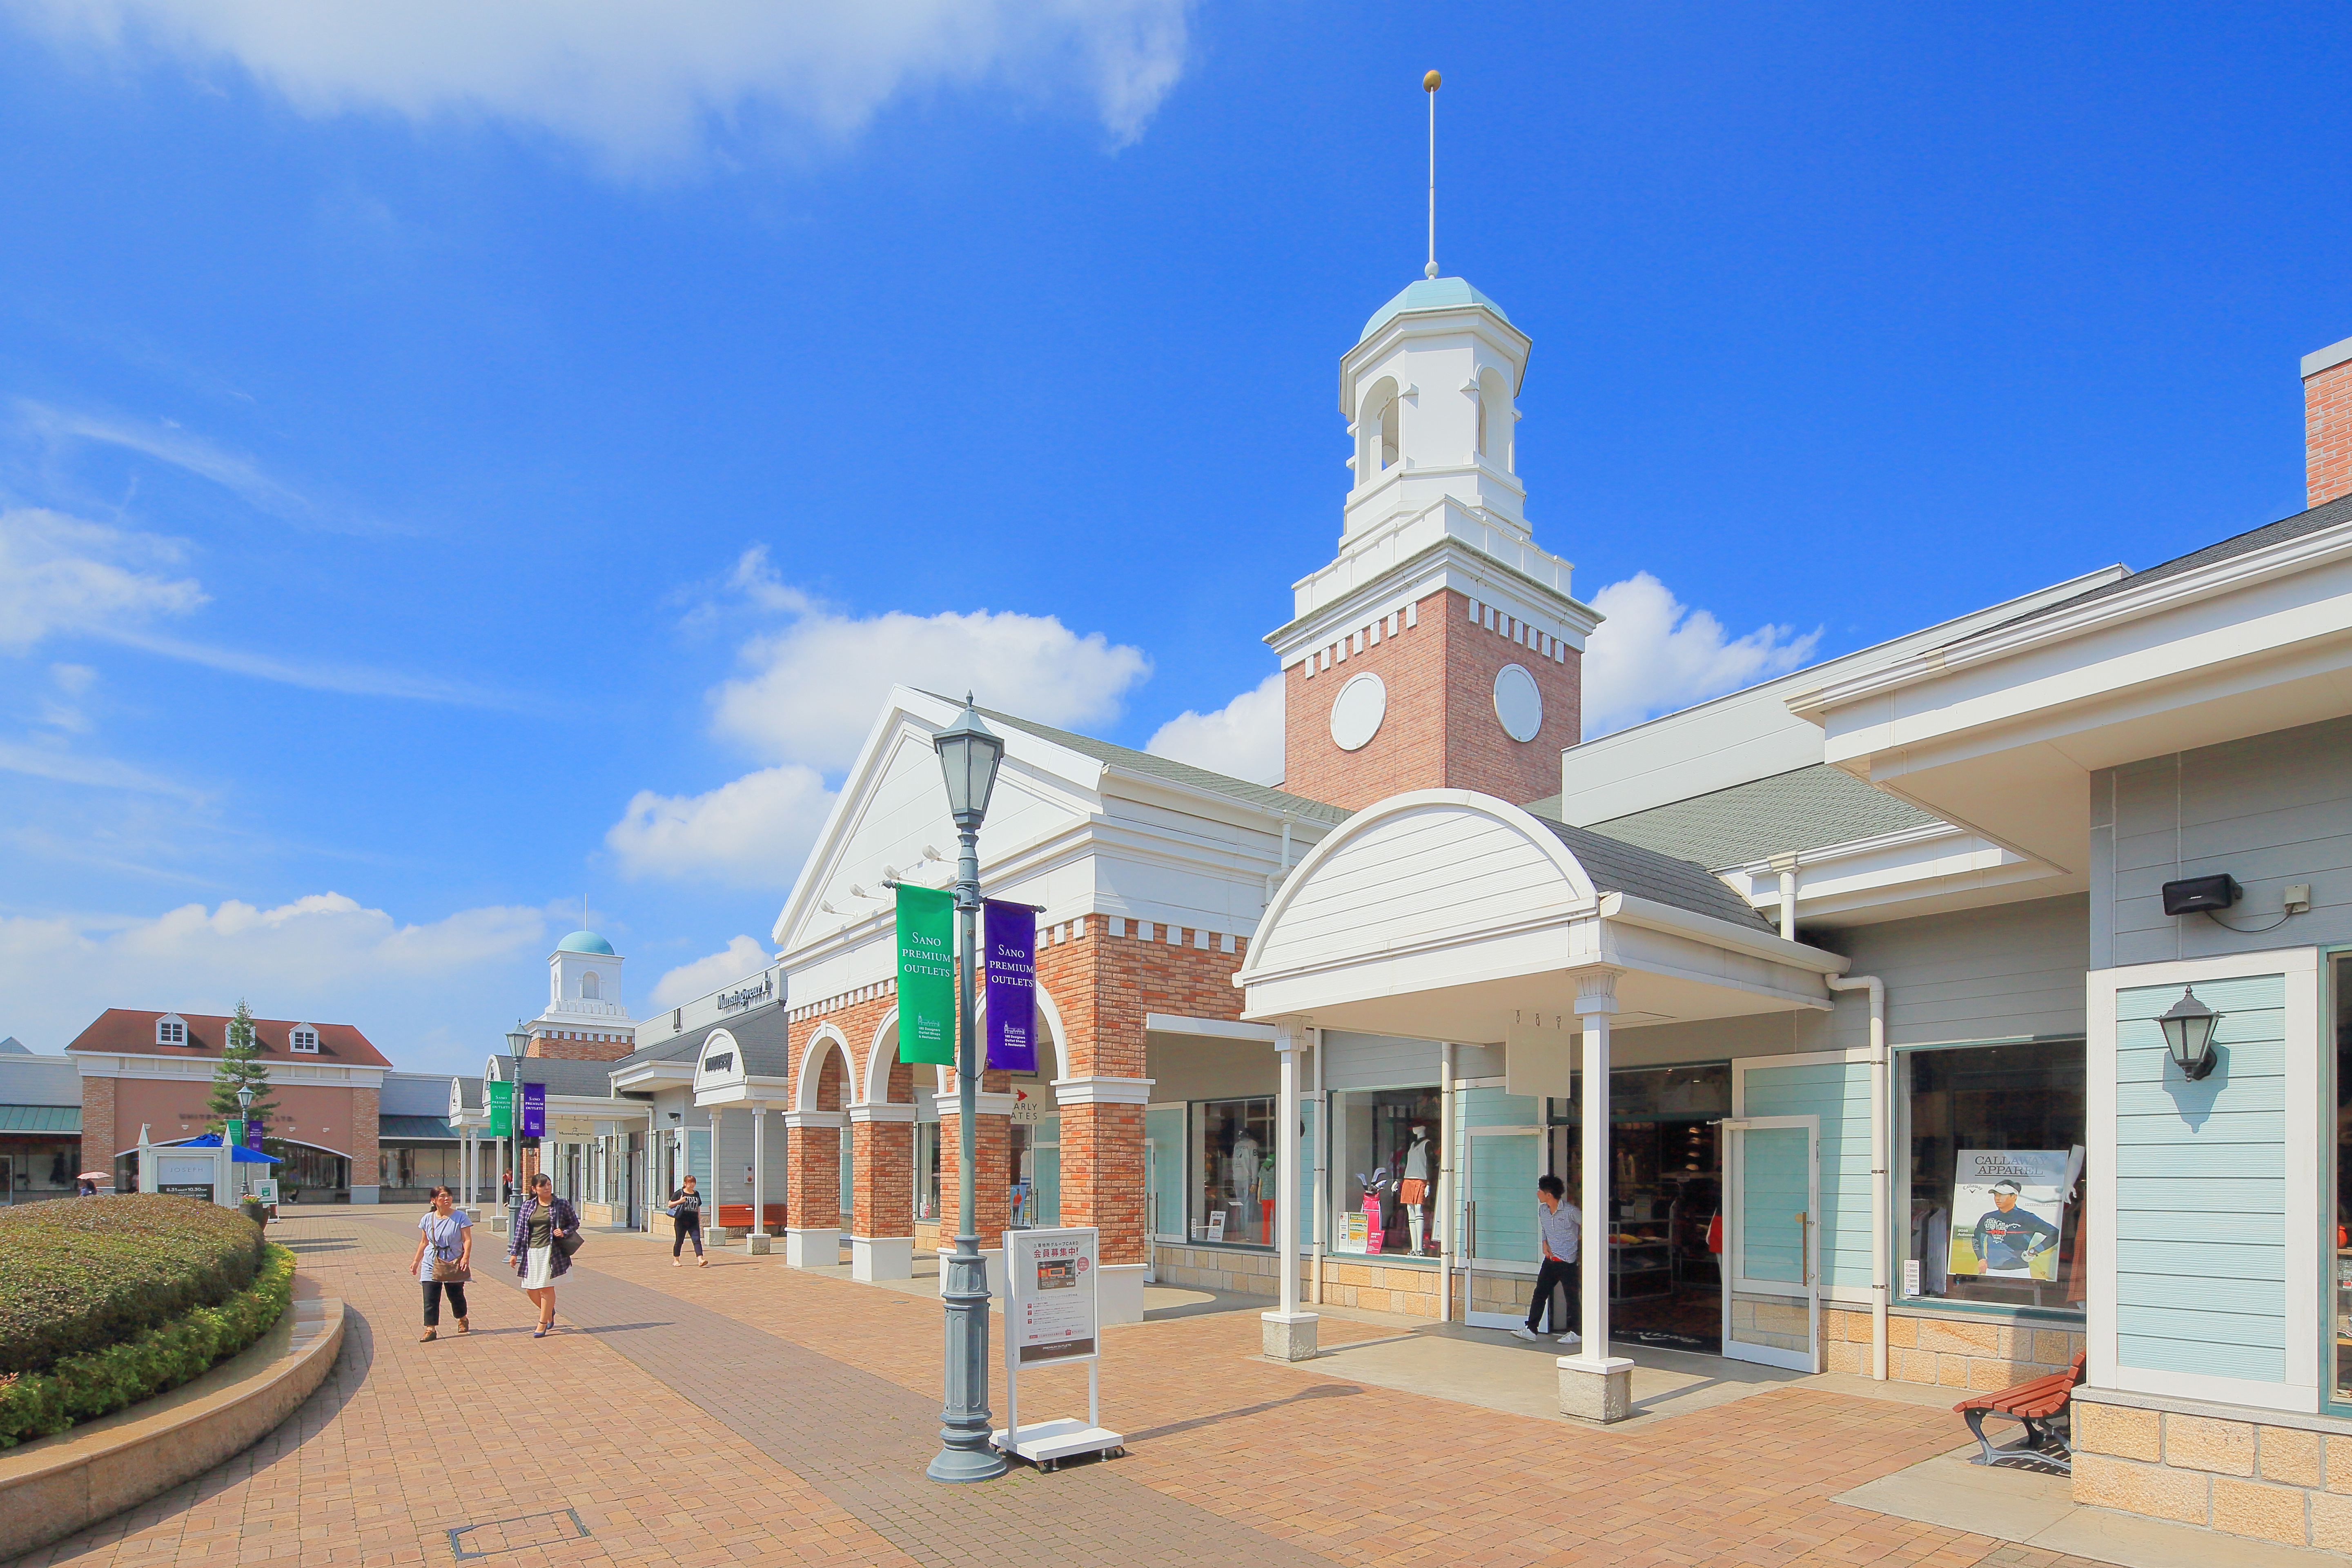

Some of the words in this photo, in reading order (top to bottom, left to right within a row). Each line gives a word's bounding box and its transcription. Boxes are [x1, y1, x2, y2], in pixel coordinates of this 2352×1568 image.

[902, 949, 951, 963] PREMIUM
[904, 964, 950, 977] OUTLETS
[989, 960, 1033, 973] PREMIUM
[991, 975, 1033, 987] OUTLETS
[717, 985, 762, 1010] Munsingwear
[1974, 1156, 2048, 1165] CALLAWAY
[1977, 1165, 2043, 1175] APPAREL
